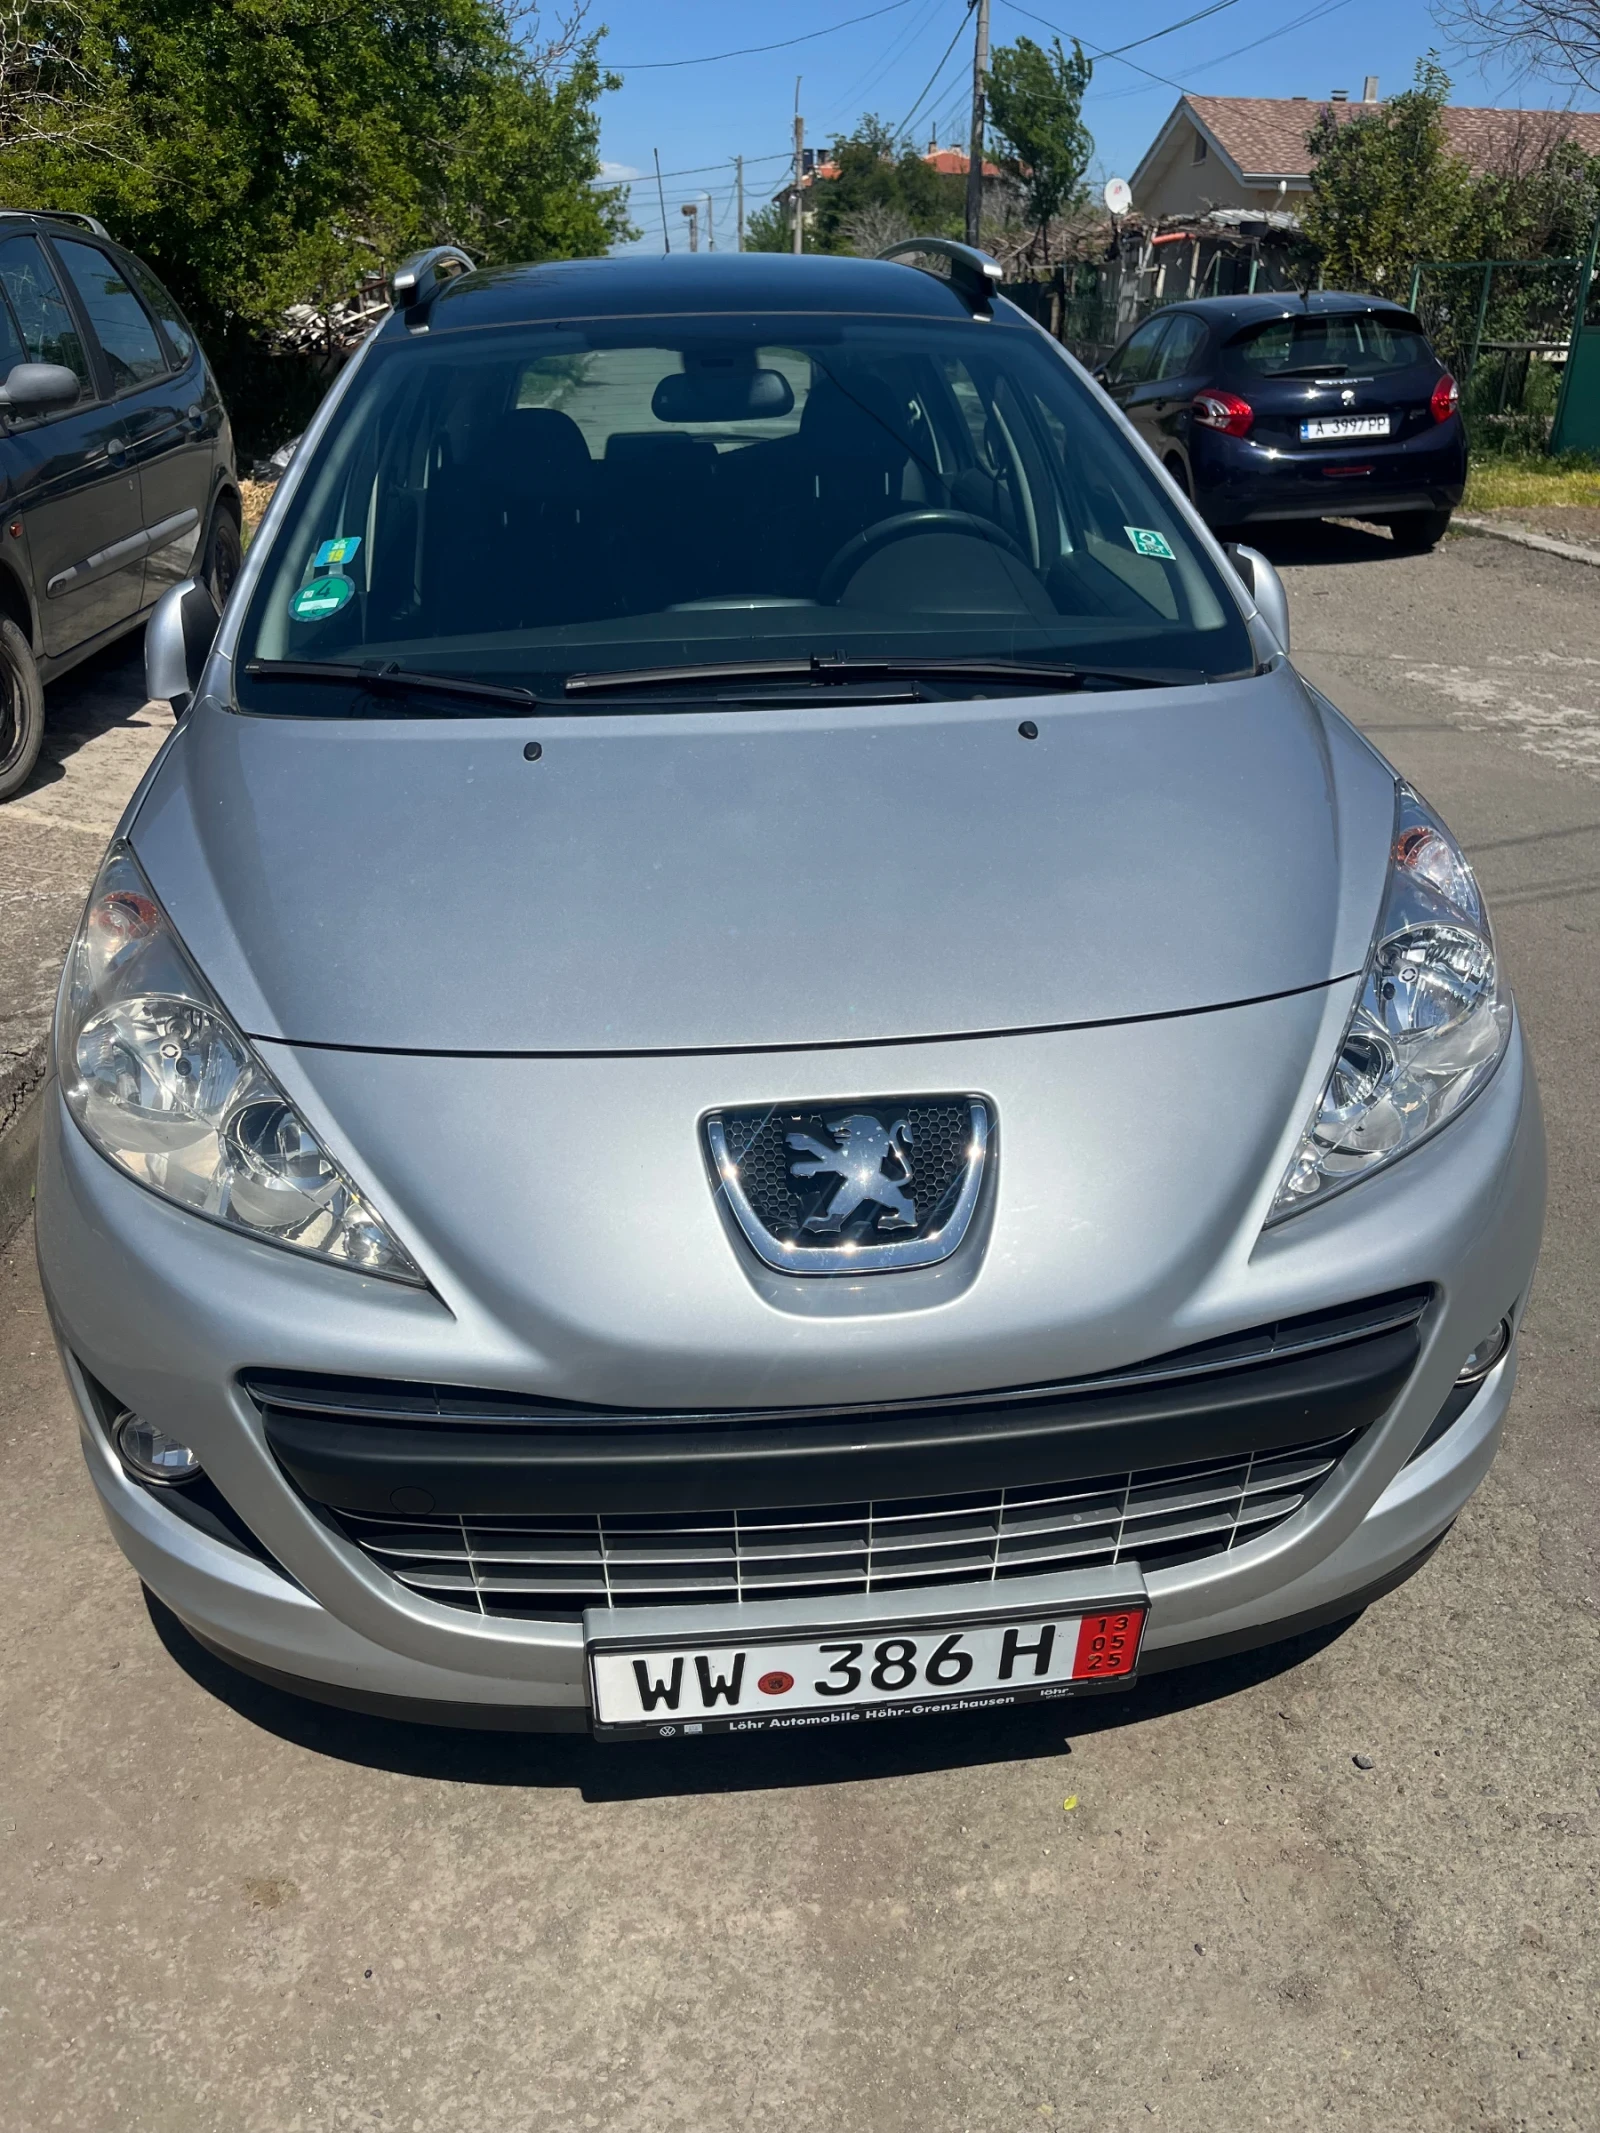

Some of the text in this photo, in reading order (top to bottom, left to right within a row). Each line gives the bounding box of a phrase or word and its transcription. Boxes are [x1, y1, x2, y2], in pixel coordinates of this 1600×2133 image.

[1316, 420, 1324, 435] A
[1332, 417, 1366, 433] 3997
[316, 580, 333, 597] 4
[1098, 1615, 1129, 1633] 13
[1092, 1633, 1126, 1651] 05
[632, 1623, 1057, 1712] WW 386 H
[1087, 1651, 1122, 1670] 25
[729, 1696, 1015, 1731] Löhr Automobile Höhr-Grenzhausen
